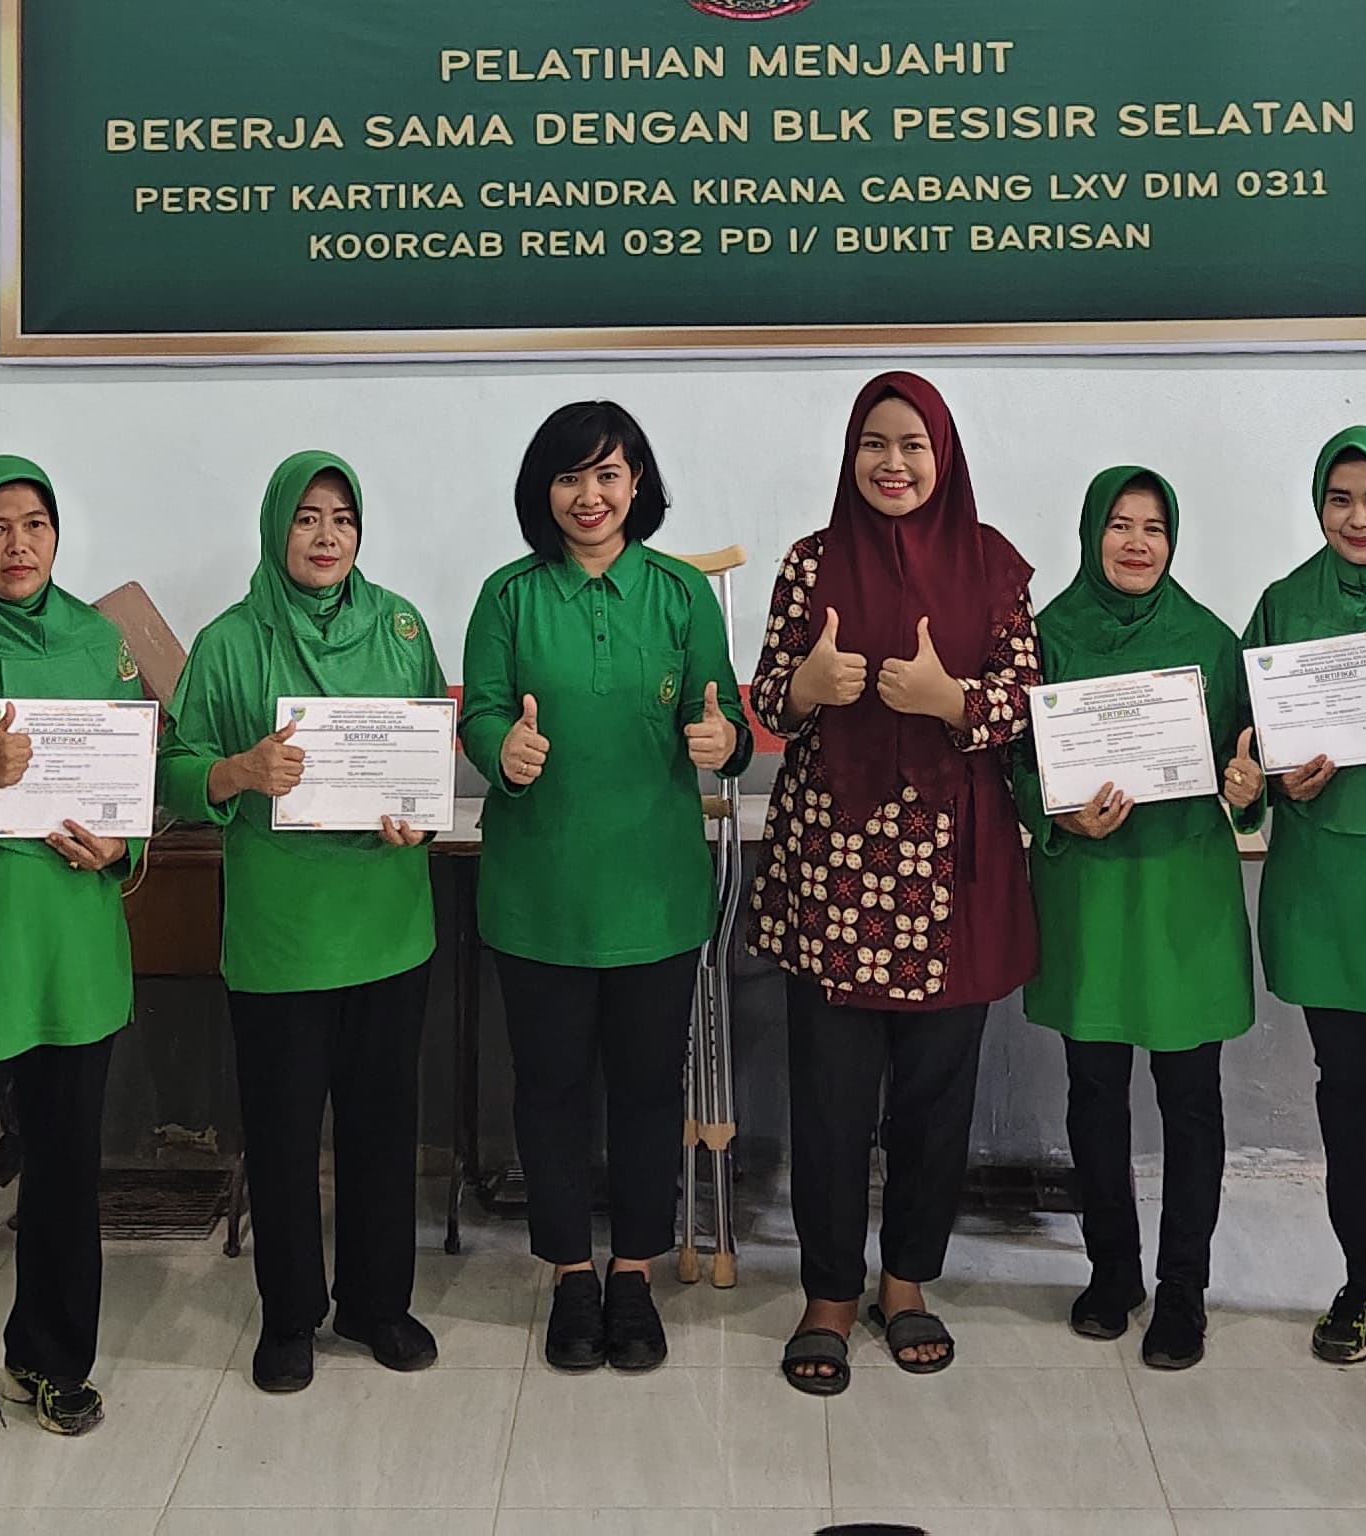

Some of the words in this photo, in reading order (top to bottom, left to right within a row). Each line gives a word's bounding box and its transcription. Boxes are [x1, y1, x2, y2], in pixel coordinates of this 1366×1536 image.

[440, 45, 725, 83] PELATIHAN
[748, 40, 1015, 78] MENJAHIT
[106, 116, 345, 152] BEKERJA
[364, 113, 515, 149] SAMA
[535, 109, 749, 146] DENGAN
[772, 107, 872, 143] BLK
[892, 104, 1097, 141] PESISIR
[1117, 99, 1355, 138] SELATAN
[135, 184, 277, 214] PERSIT
[291, 182, 465, 212] KARTIKA
[479, 178, 677, 208] CHANDRA
[692, 176, 846, 205] KIRANA
[860, 174, 1033, 204] CABANG
[1049, 172, 1128, 201] LXV
[1143, 171, 1219, 200] DIM
[1235, 168, 1328, 198] 0311
[309, 230, 504, 260] KOORCAB
[520, 229, 606, 258] REM
[623, 228, 703, 256] 032
[719, 227, 773, 255] PD
[789, 225, 819, 254] I/
[835, 224, 955, 254] BUKIT
[969, 222, 1151, 252] BARISAN
[1315, 670, 1357, 682] SERTIFIKAT
[1098, 708, 1140, 720] SERTIFIKAT
[41, 736, 87, 744] SERTIFIKAT
[344, 733, 388, 741] SERTIFIKAT
